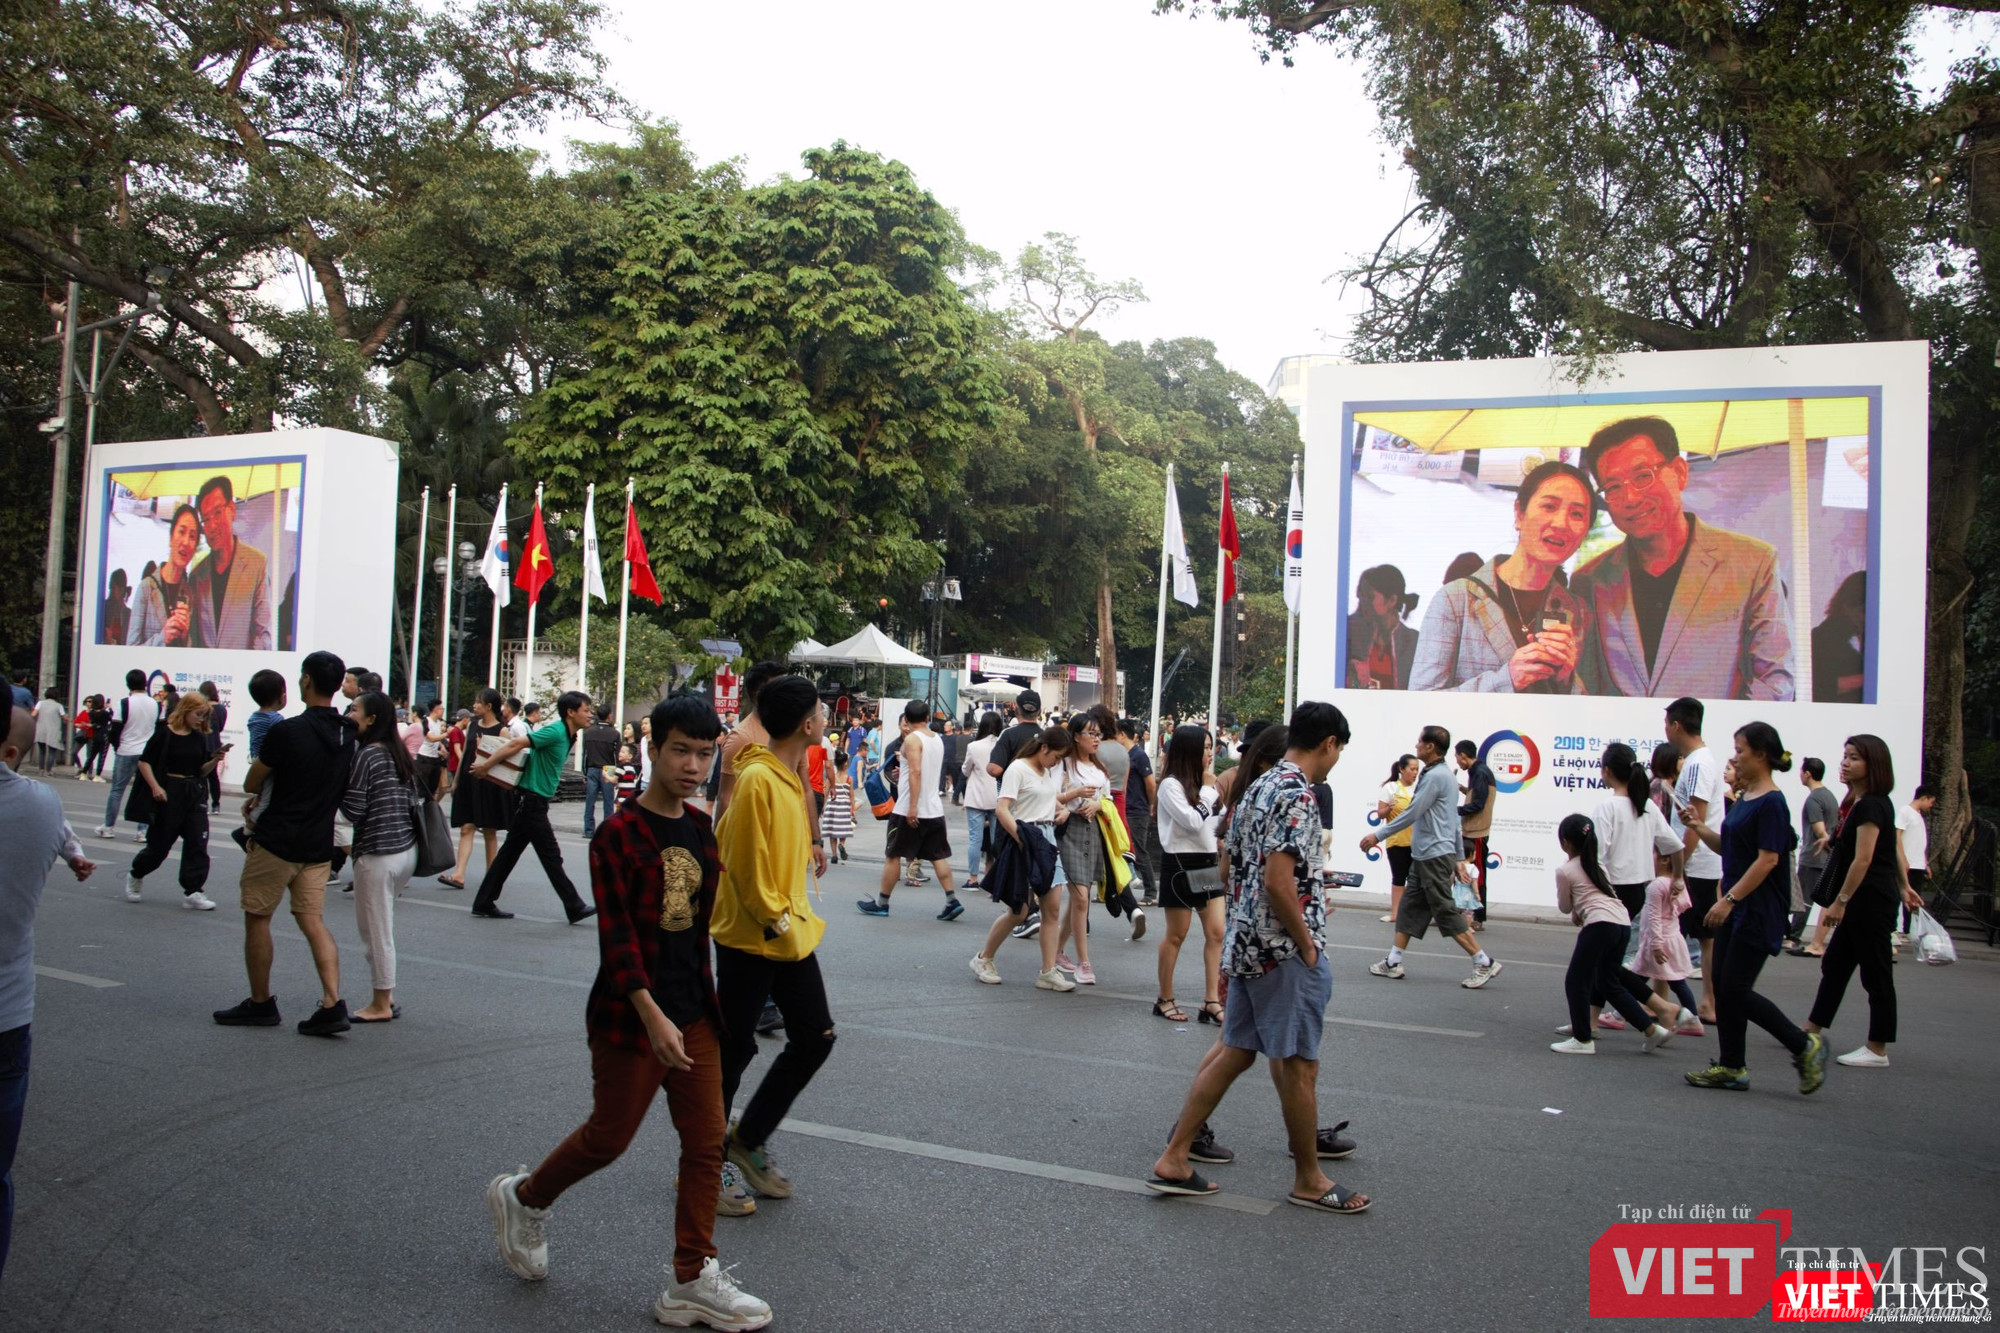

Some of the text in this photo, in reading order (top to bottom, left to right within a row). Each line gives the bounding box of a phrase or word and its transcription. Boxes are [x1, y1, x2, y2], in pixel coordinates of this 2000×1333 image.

[1417, 461, 1441, 471] 6,000
[727, 699, 738, 708] AID
[1554, 736, 1585, 750] 2019
[1553, 754, 1565, 767] LỄ
[1567, 757, 1586, 770] HỘI
[1553, 772, 1610, 792] VIỆT NA
[1506, 855, 1544, 866] 한국문화원
